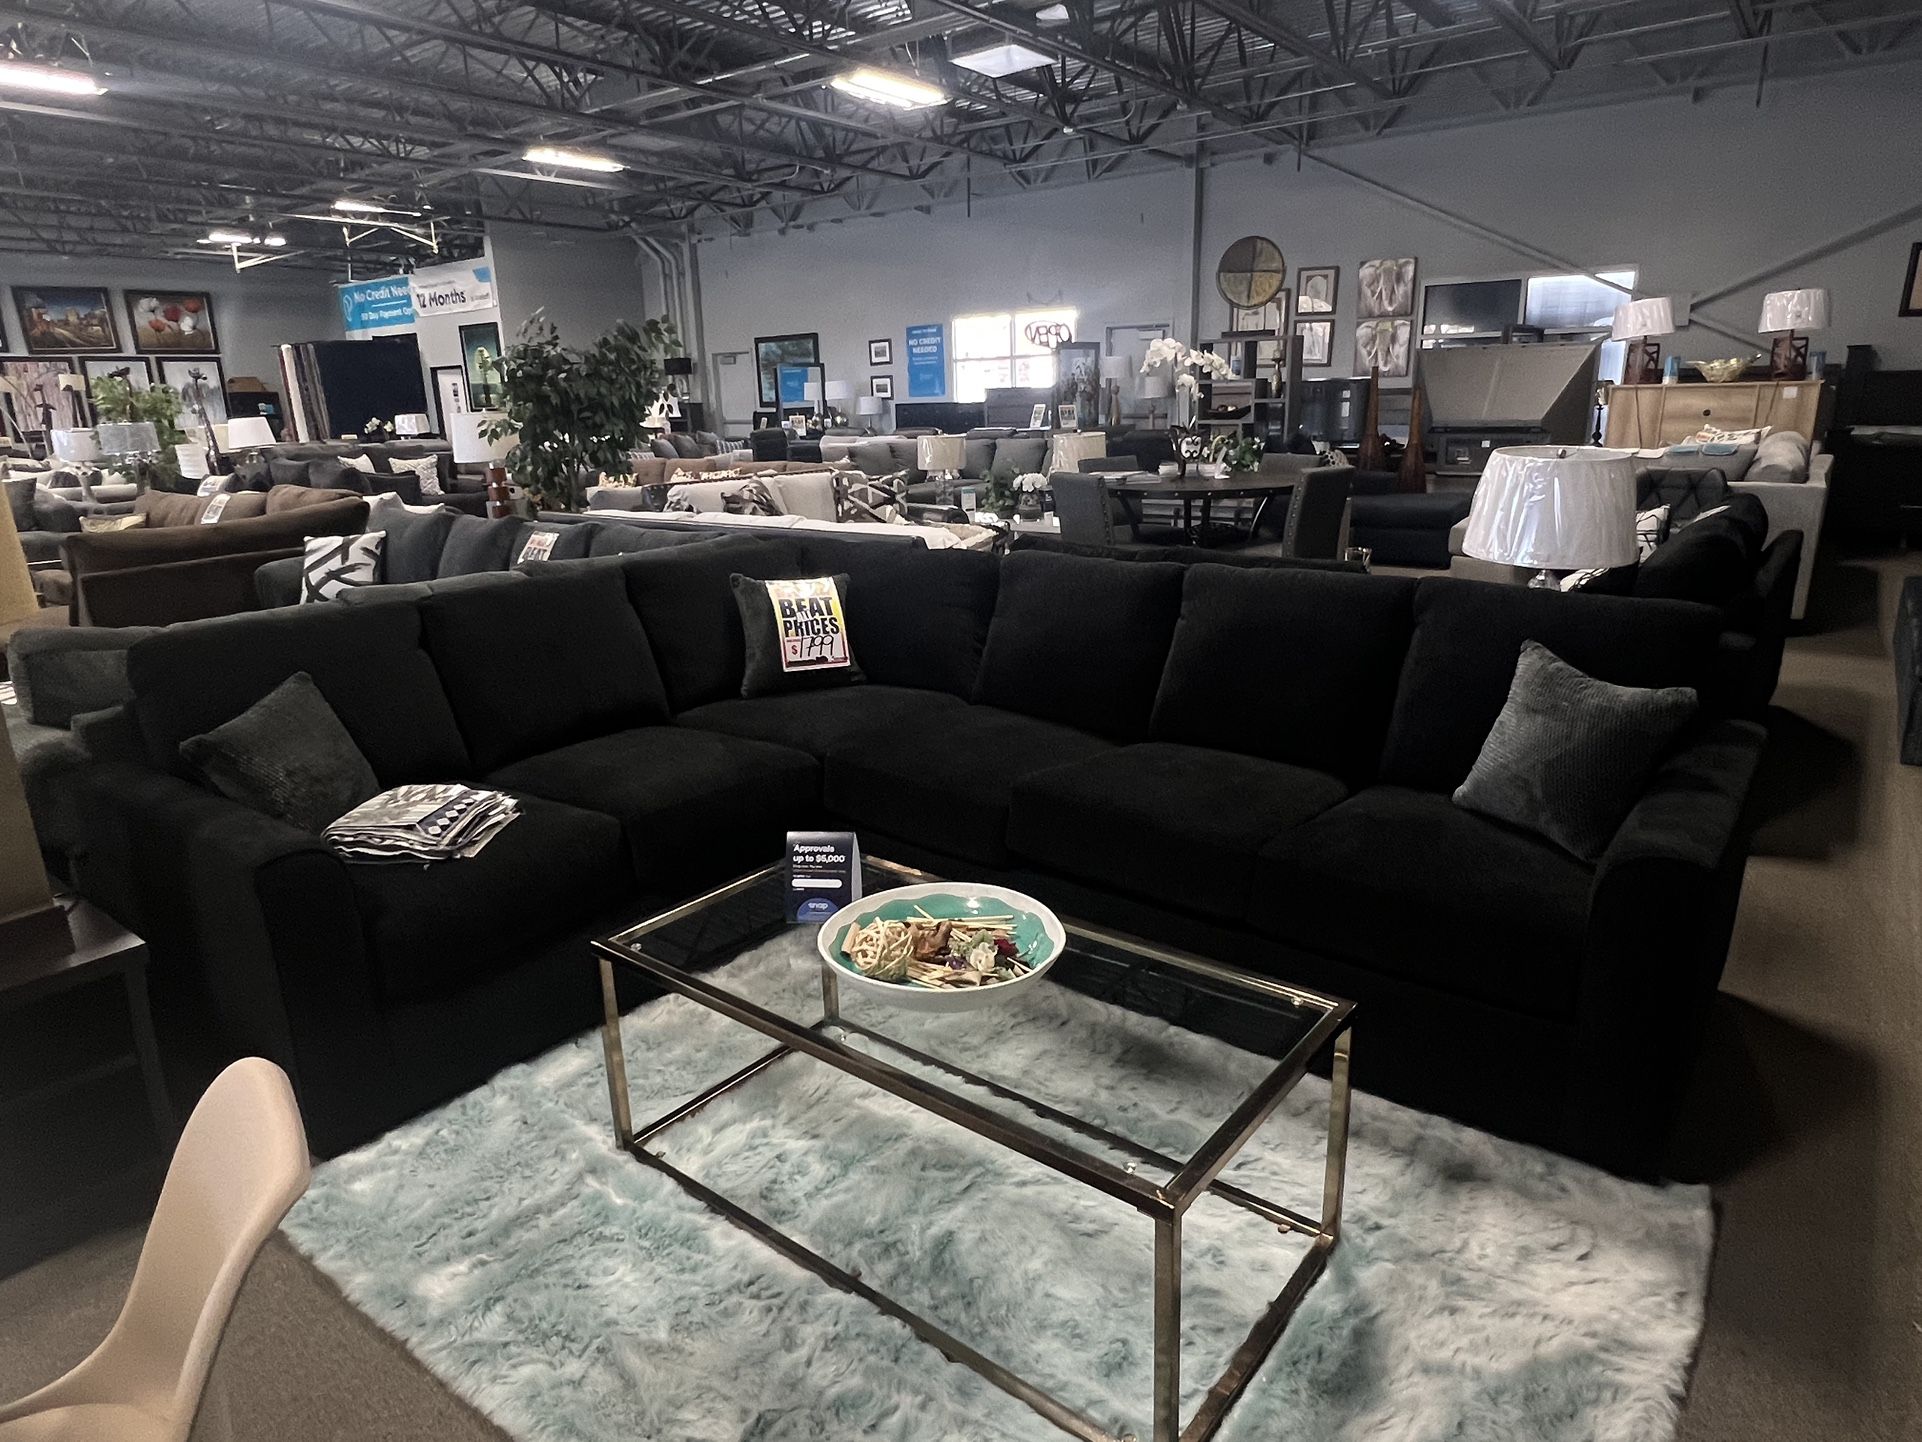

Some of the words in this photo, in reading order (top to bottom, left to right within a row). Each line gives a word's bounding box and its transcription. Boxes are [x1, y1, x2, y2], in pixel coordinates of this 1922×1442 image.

[354, 291, 365, 303] No
[366, 286, 390, 300] Credit
[416, 293, 427, 308] 12
[428, 288, 467, 307] Months
[919, 336, 942, 346] CREDIT
[912, 346, 938, 354] NEEDED
[778, 597, 834, 618] BEAT
[782, 617, 840, 637] PRICES
[793, 844, 835, 854] Approvals
[792, 855, 804, 863] up
[805, 855, 814, 863] to
